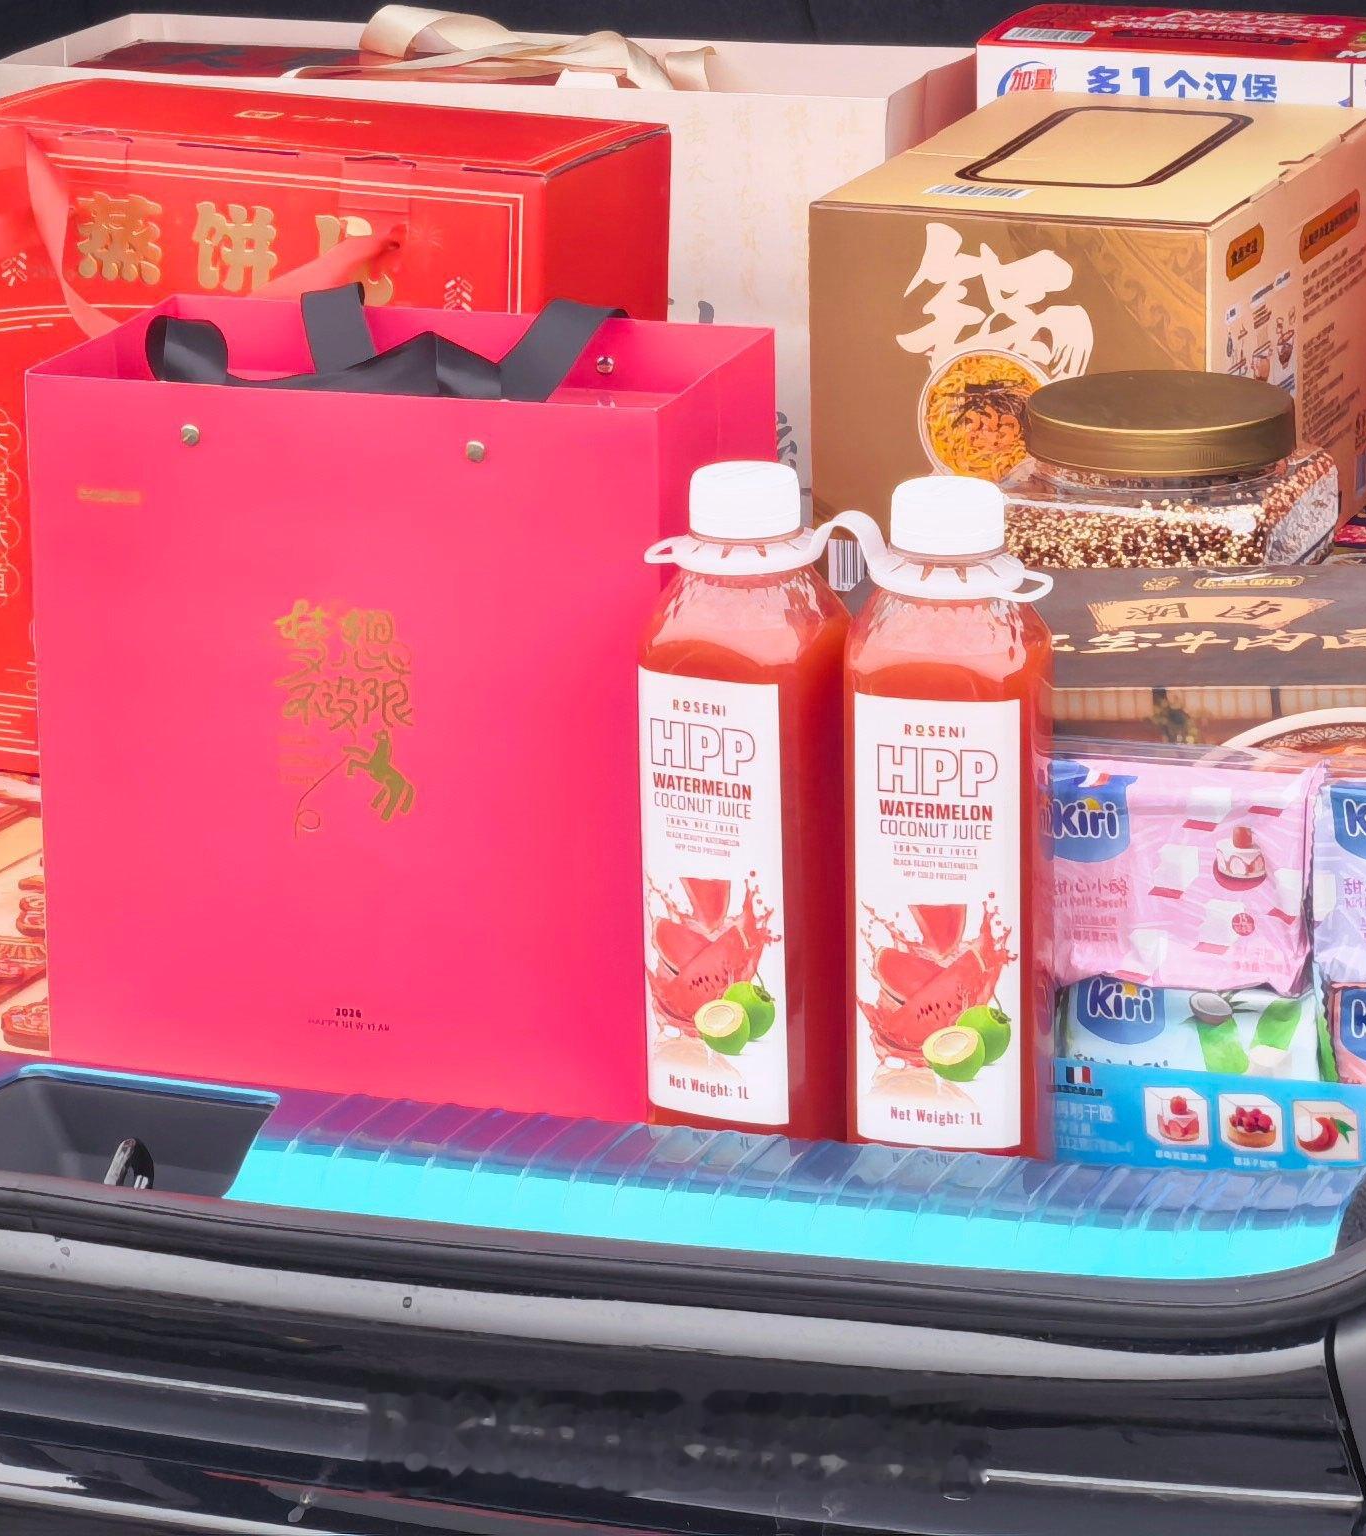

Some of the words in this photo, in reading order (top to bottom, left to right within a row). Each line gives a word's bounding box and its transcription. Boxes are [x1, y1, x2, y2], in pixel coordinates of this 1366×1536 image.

[650, 717, 756, 776] HPP
[876, 743, 999, 798] HPP
[653, 771, 753, 801] WATERMELON
[654, 791, 712, 814] COCONUT
[717, 801, 752, 820] JUICE
[879, 798, 993, 822] WATERMELON
[1052, 797, 1120, 840] Kiri
[880, 819, 949, 839] COCONUT
[952, 824, 993, 840] JUICE
[1088, 976, 1155, 1024] Kiri
[668, 1073, 686, 1090] Net
[690, 1077, 734, 1099] Weight:
[737, 1085, 750, 1100] 1L
[890, 1106, 911, 1122] Net
[915, 1109, 965, 1126] Weight:
[969, 1112, 984, 1126] 1L
